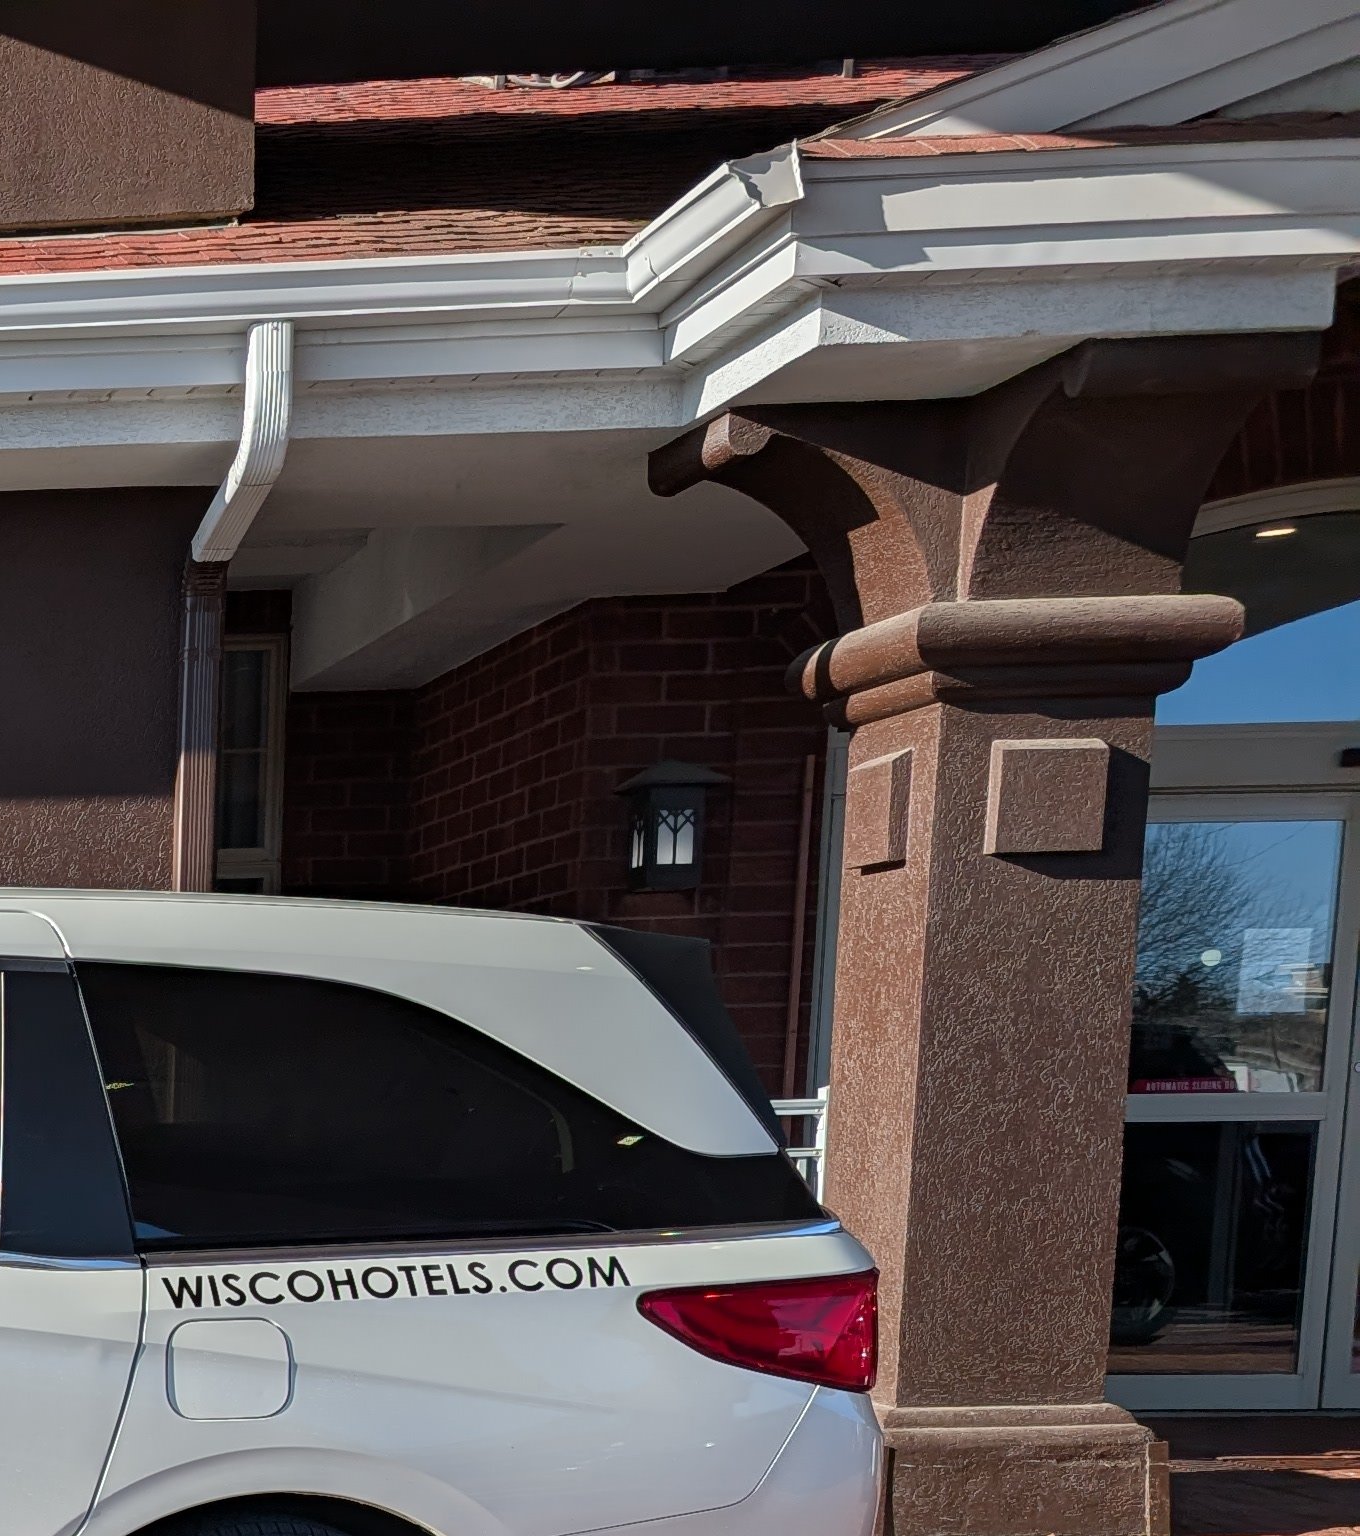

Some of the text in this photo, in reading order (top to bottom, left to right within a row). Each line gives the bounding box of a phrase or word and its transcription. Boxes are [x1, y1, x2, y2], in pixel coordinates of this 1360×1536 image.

[1146, 1081, 1189, 1091] AUTOMATIC
[1192, 1080, 1222, 1090] SLIDING
[161, 1256, 631, 1309] WISCOHOTELS.COM
